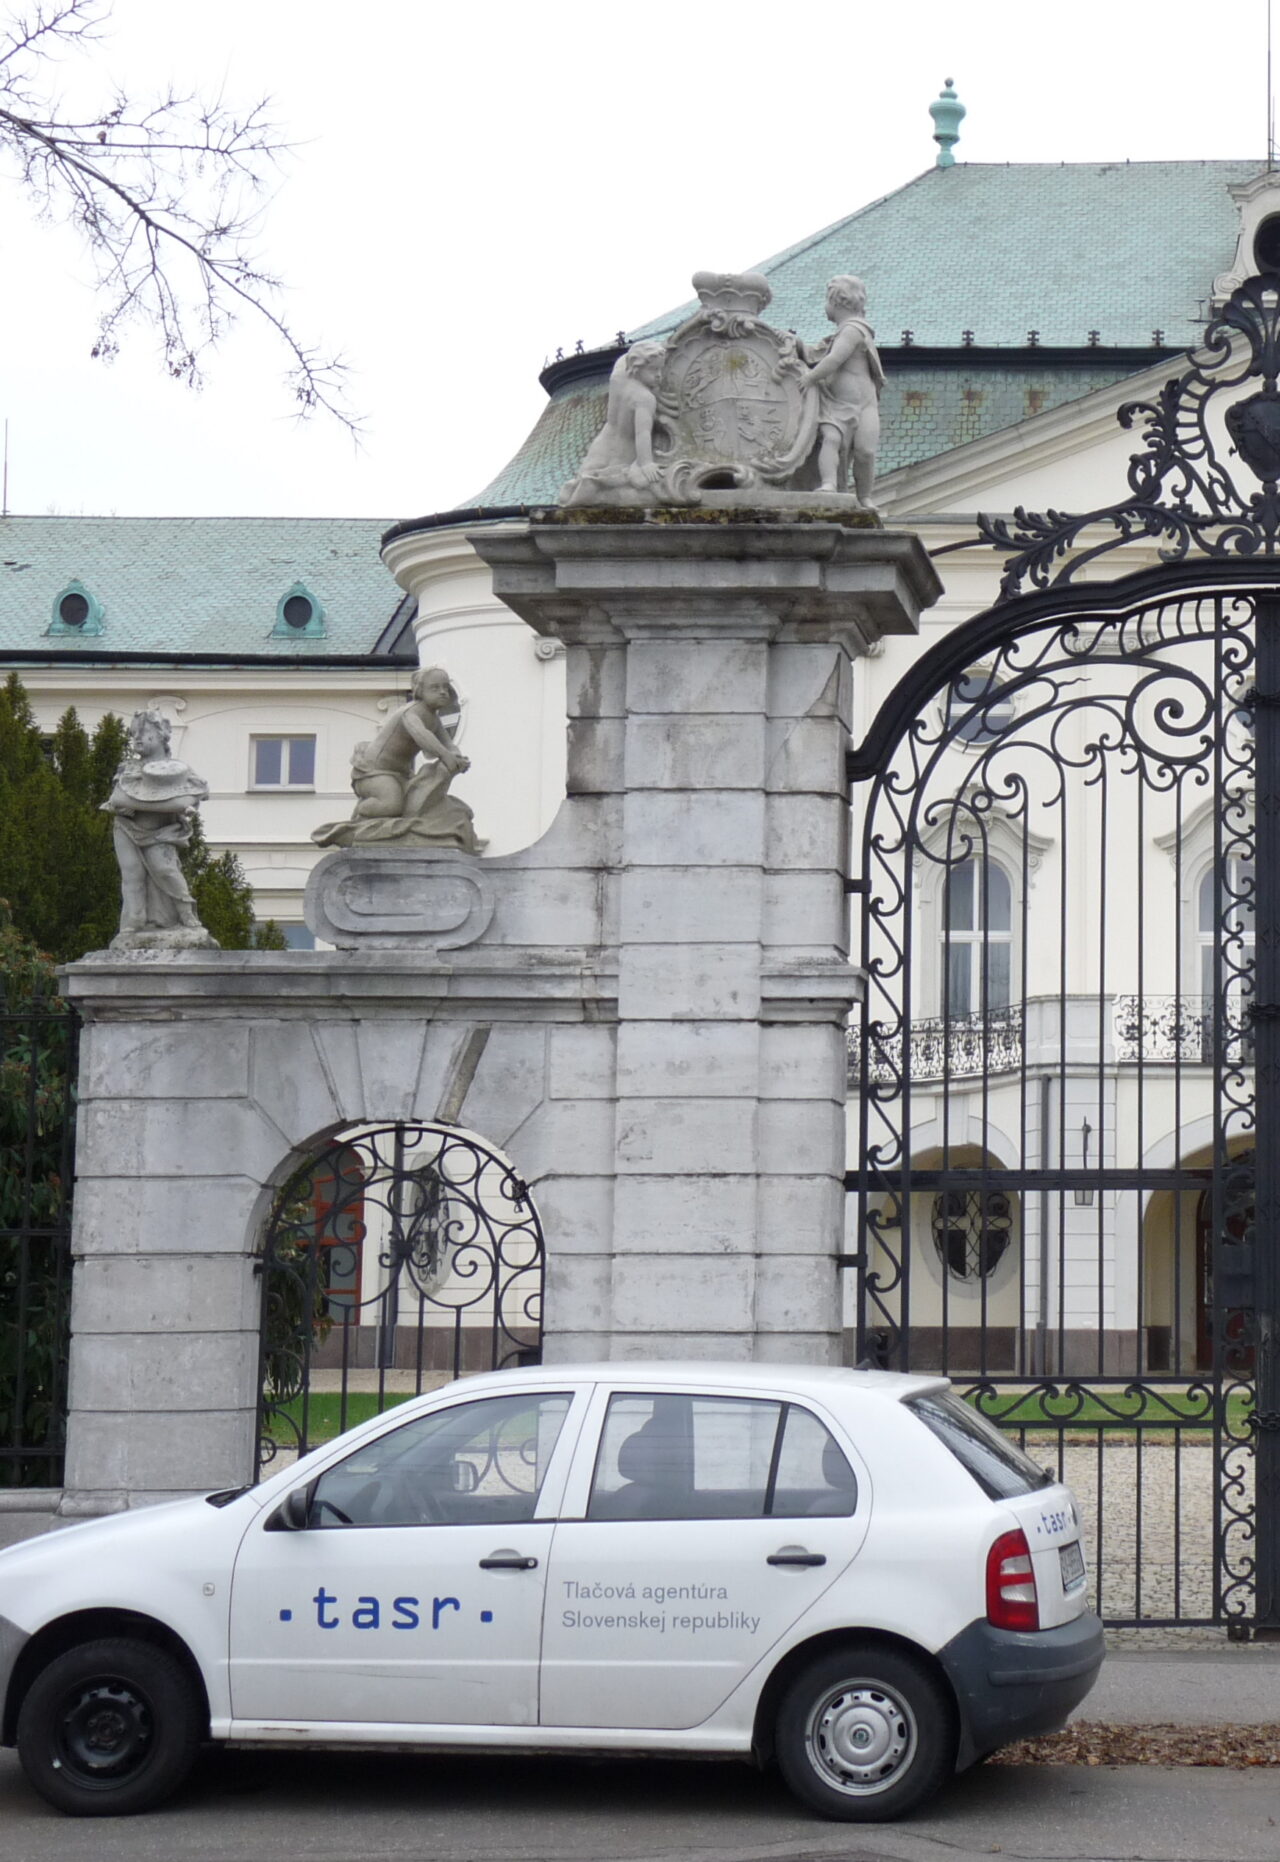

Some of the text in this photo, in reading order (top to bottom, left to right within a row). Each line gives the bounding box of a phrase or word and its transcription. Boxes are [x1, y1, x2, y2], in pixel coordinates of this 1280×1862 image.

[563, 1581, 729, 1604] Tlačová agentúra
[562, 1610, 761, 1634] Slovenskej republiky
